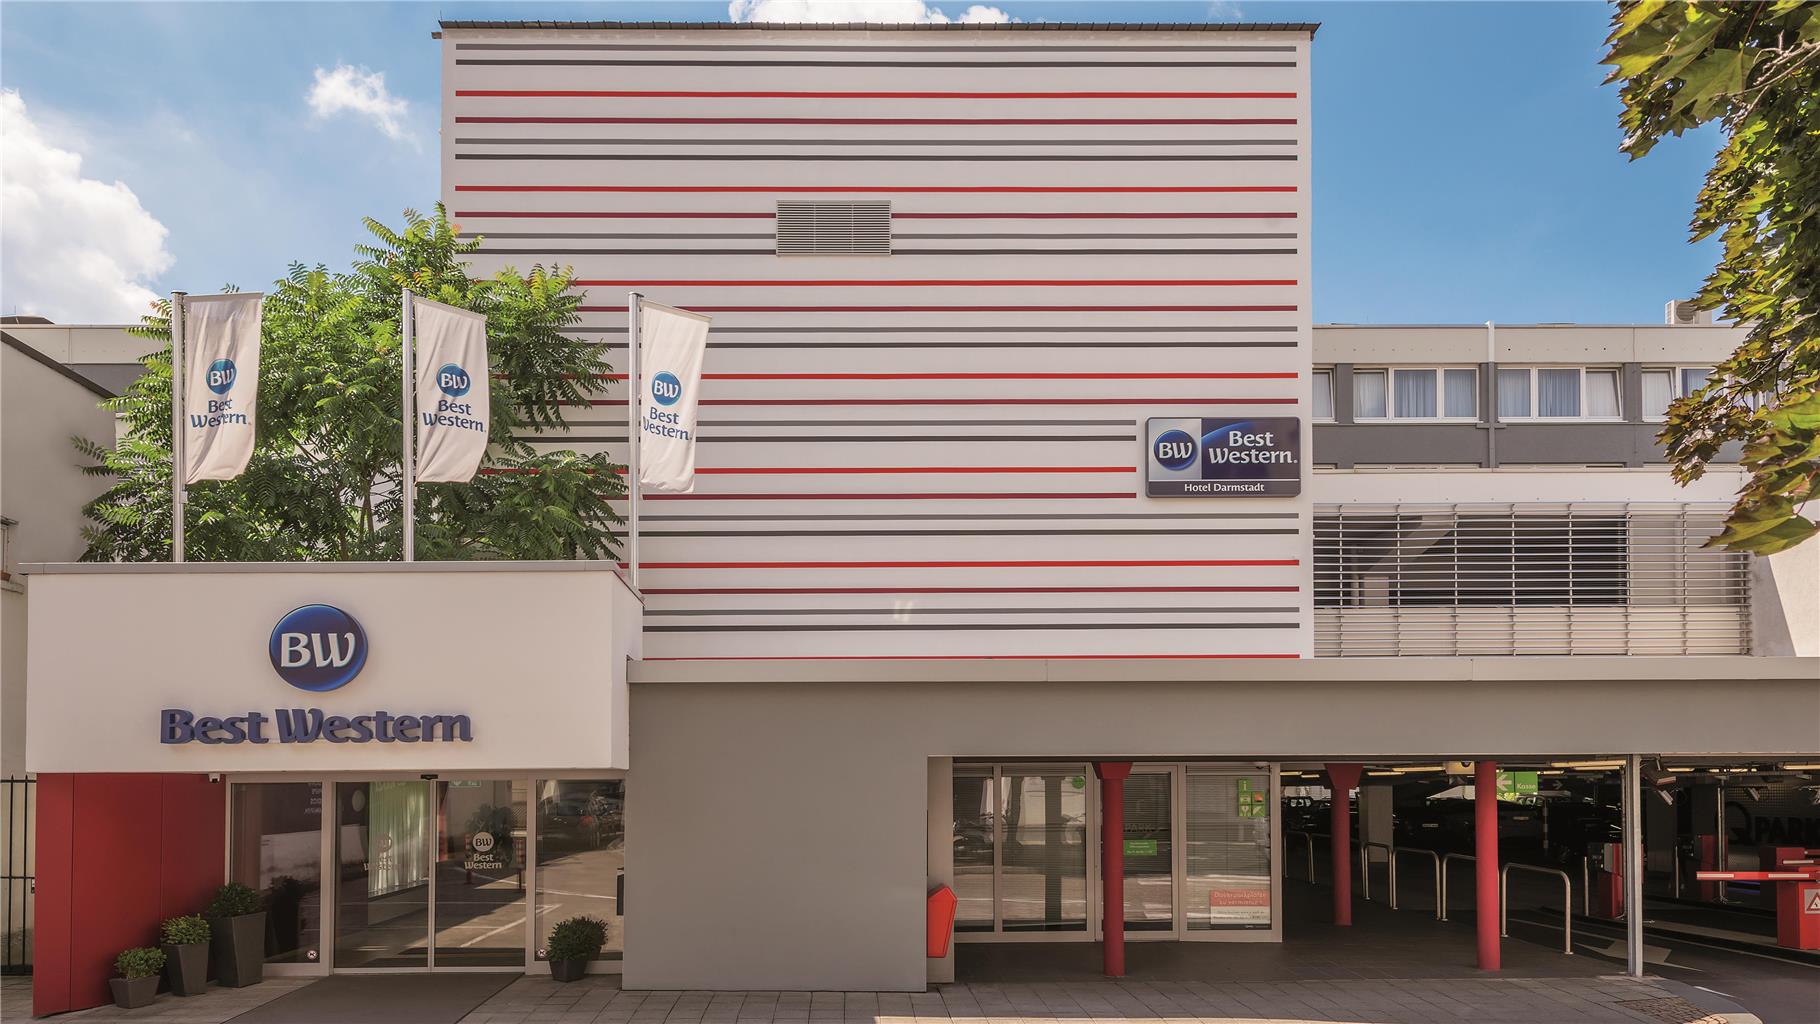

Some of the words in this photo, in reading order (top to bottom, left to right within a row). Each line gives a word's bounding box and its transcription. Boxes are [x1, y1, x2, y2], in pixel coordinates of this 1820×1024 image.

[209, 368, 235, 387] BW
[440, 372, 468, 390] BW
[653, 379, 679, 399] BW
[208, 398, 233, 414] Best
[438, 399, 472, 416] Best
[649, 406, 680, 425] Best
[1229, 430, 1274, 447] Best
[1158, 442, 1193, 459] BW
[1184, 483, 1211, 492] Hotel
[1213, 483, 1265, 492] Darmstadt
[280, 631, 356, 668] BW
[160, 708, 269, 744] Best
[274, 707, 474, 744] Western
[474, 838, 492, 847] BW
[464, 861, 502, 870] Western
[472, 853, 494, 862] Best
